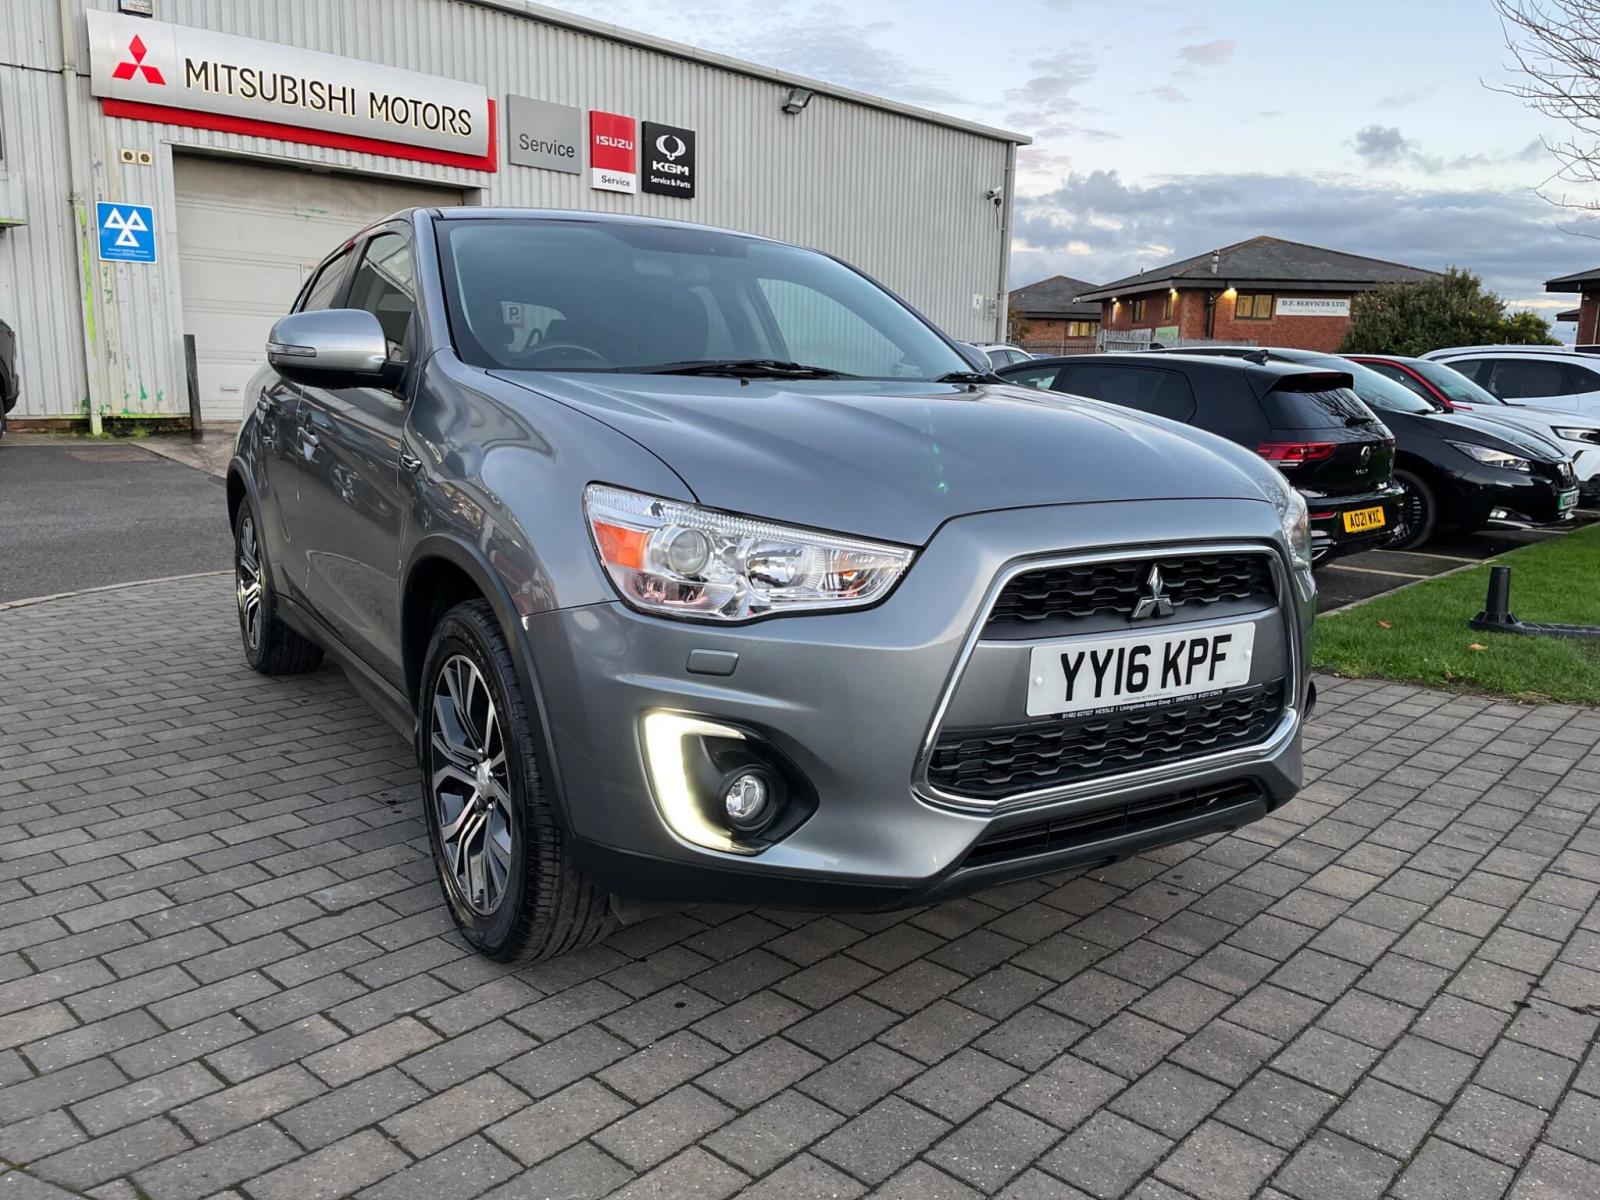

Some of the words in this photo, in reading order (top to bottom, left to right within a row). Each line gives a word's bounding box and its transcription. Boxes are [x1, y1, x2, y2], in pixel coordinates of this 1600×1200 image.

[185, 58, 356, 116] MITSUBISHI
[369, 91, 472, 136] MOTORS
[519, 133, 575, 158] Service
[596, 135, 633, 150] ISUZU
[652, 160, 690, 176] KGM
[601, 175, 631, 187] Service
[650, 175, 671, 186] Service
[676, 179, 691, 189] Parts
[1296, 300, 1330, 308] SERVICES
[1060, 644, 1152, 702] YY16
[1160, 633, 1233, 689] KPF
